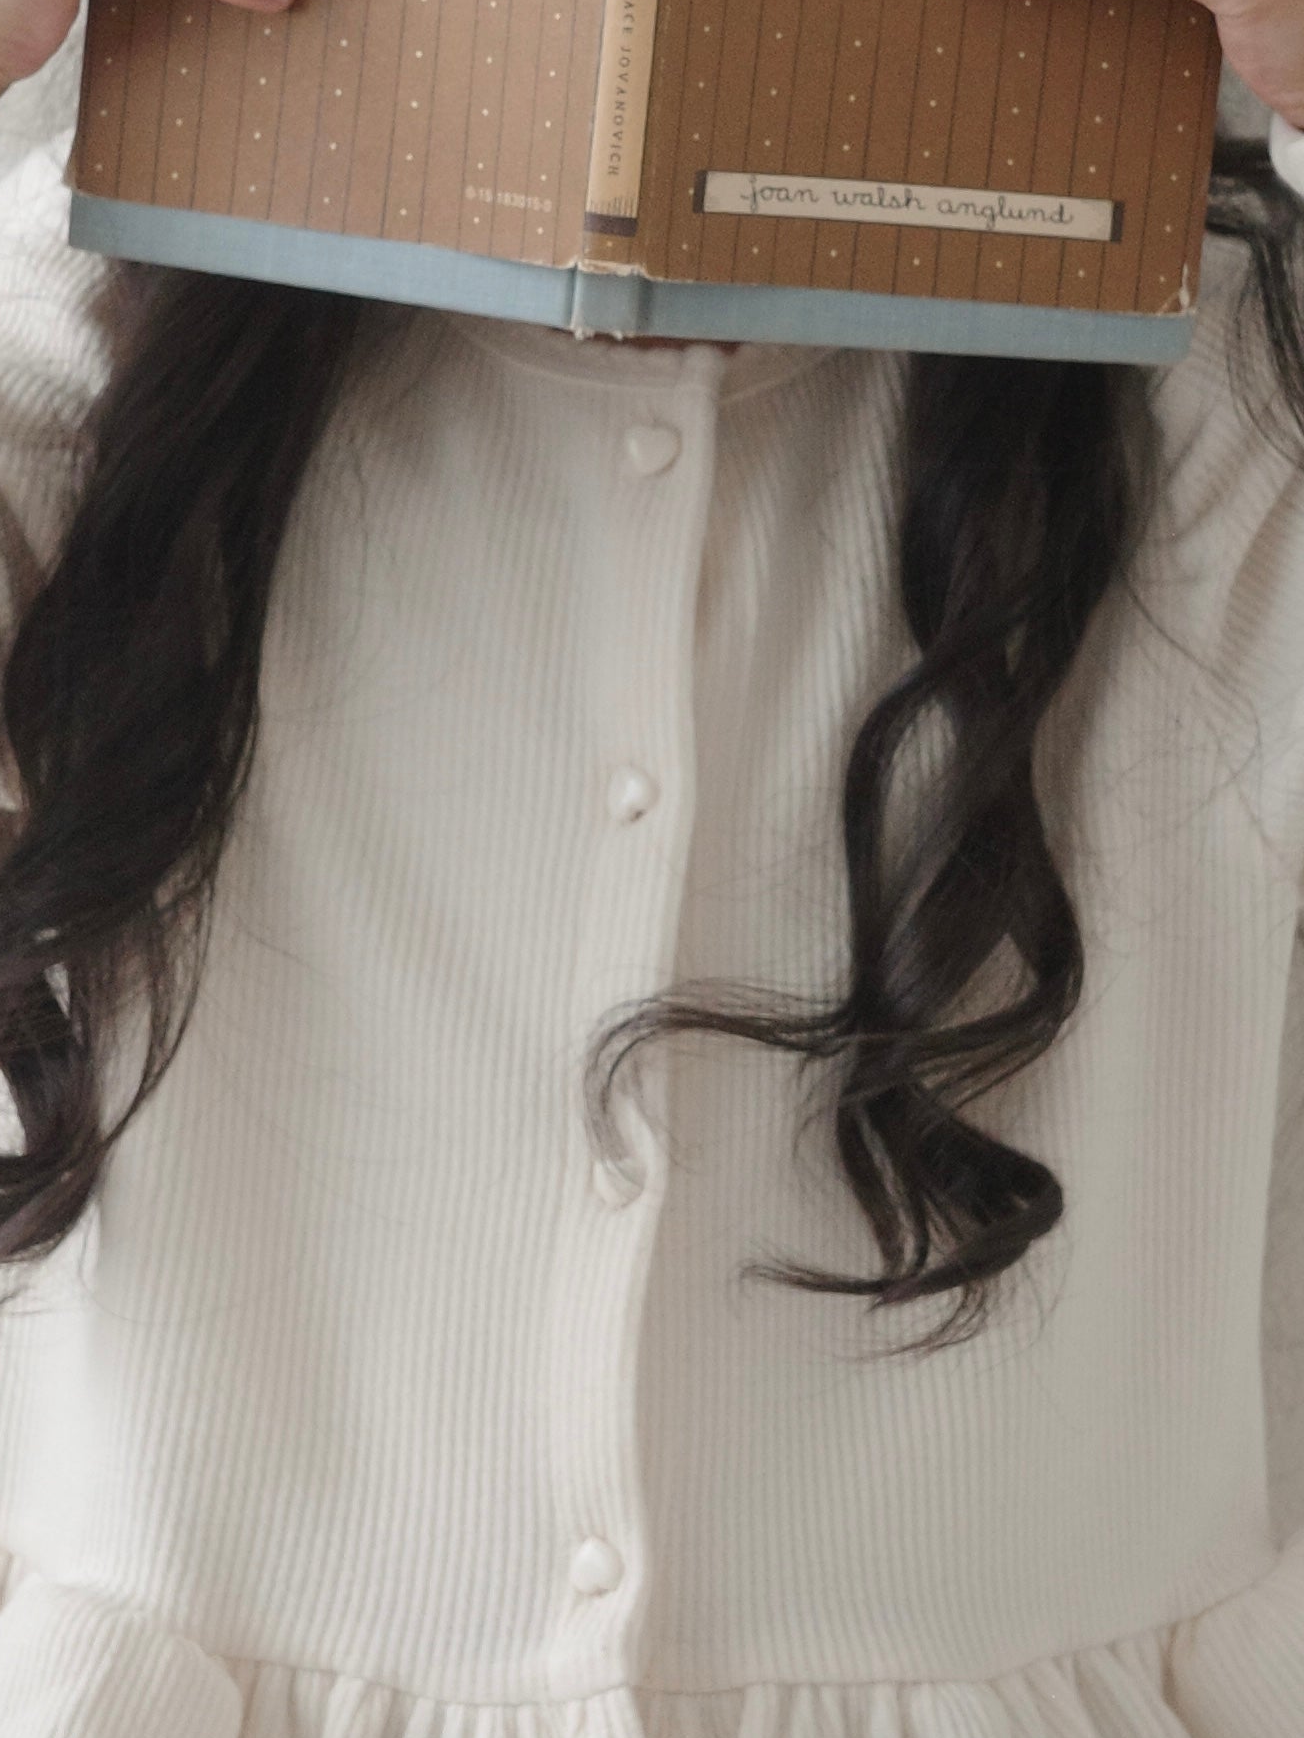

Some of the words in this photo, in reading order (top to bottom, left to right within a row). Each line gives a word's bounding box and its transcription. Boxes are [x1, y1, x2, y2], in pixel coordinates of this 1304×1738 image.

[740, 173, 820, 214] joan
[830, 187, 926, 211] walsh
[937, 196, 1074, 229] anglund
